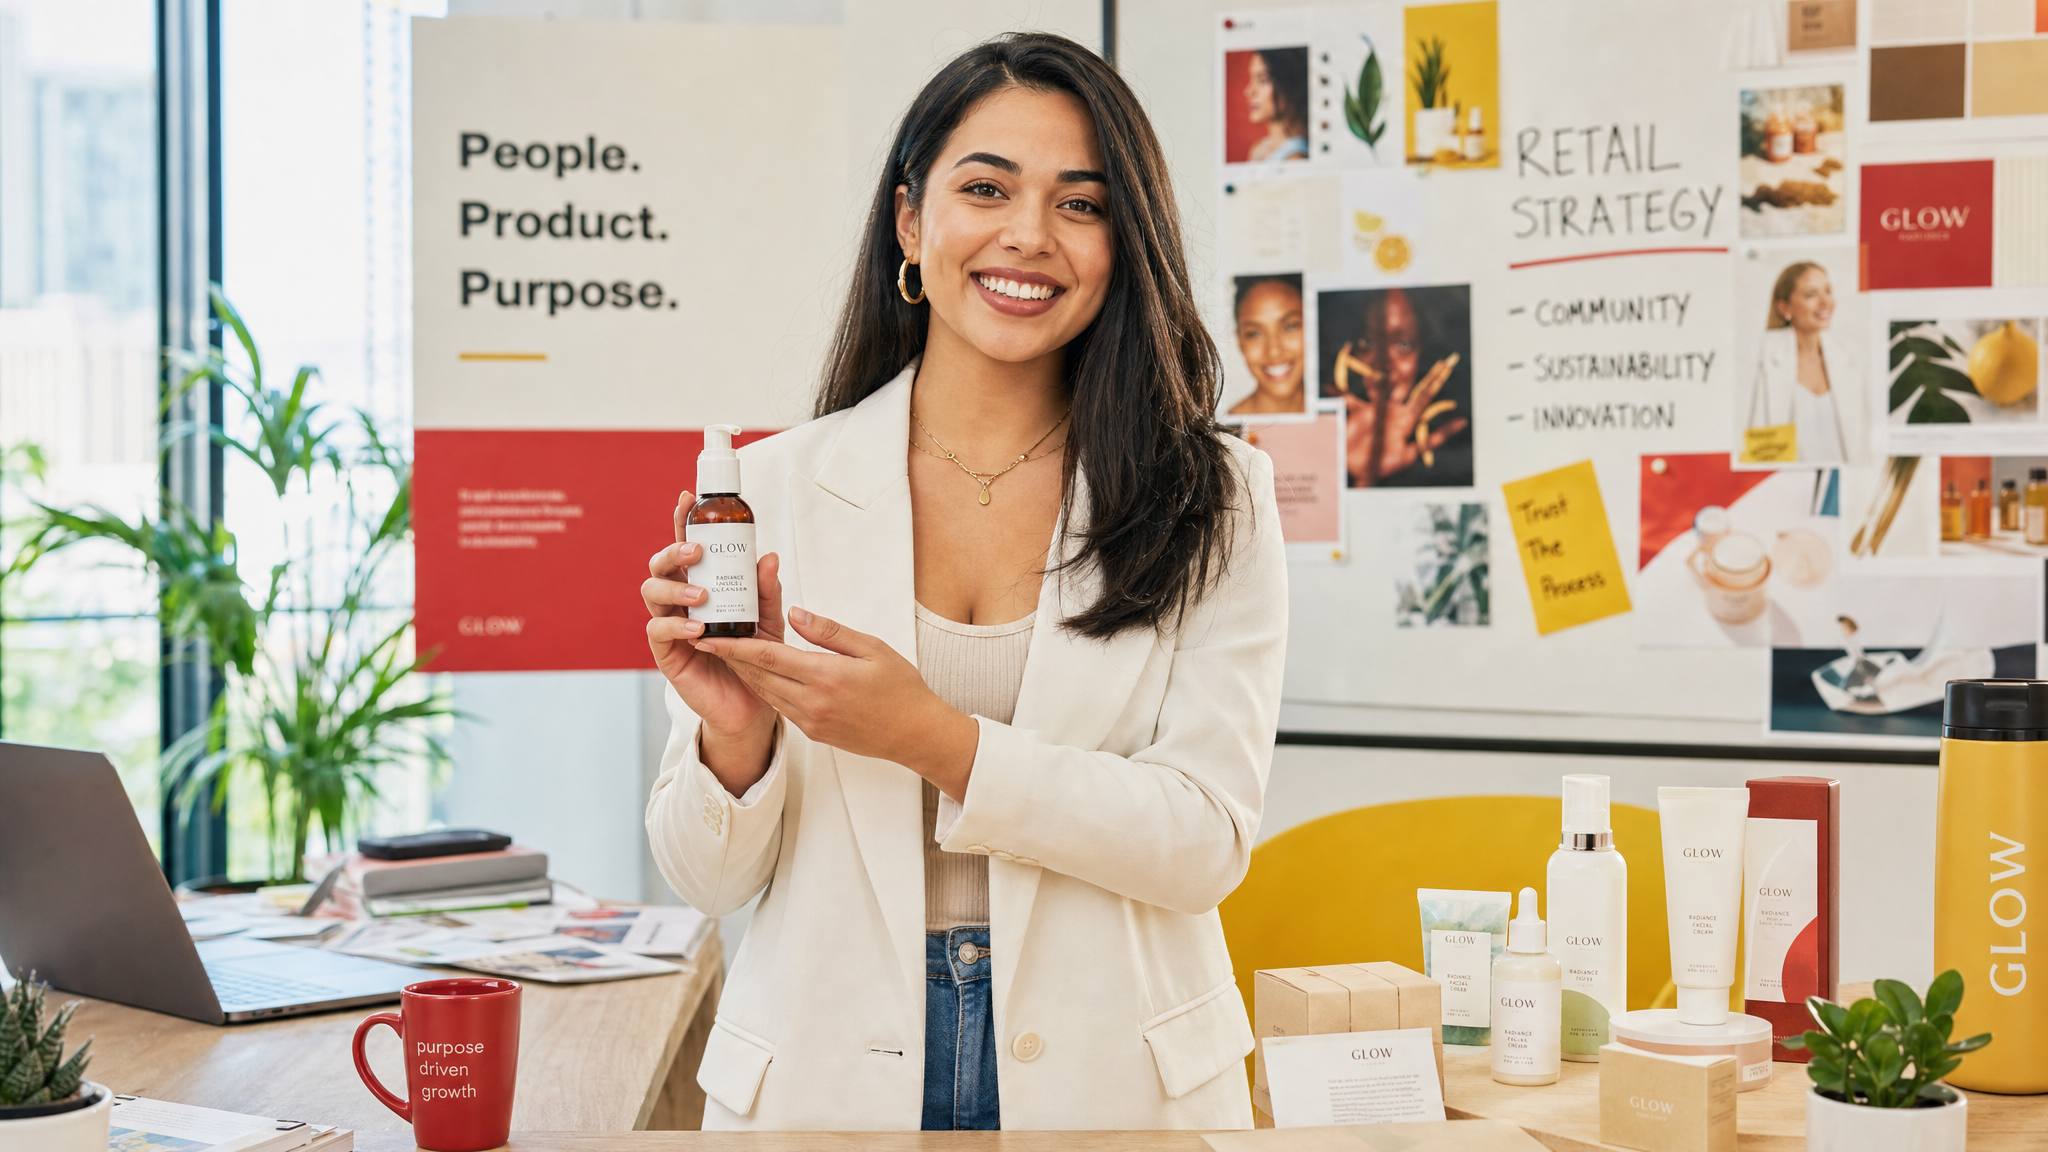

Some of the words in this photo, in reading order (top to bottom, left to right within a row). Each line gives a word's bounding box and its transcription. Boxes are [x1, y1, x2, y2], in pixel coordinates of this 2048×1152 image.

[459, 132, 641, 178] People.
[1517, 124, 1681, 178] RETAIL
[459, 201, 670, 241] Product.
[1511, 185, 1723, 239] STRATEGY
[1880, 205, 1970, 231] GLOW
[459, 269, 679, 317] Purpose.
[1534, 293, 1690, 327] COMMUNITY
[1533, 351, 1715, 382] SUSTAINABILITY
[1533, 402, 1675, 431] INNOVATION
[1516, 492, 1568, 525] Trust
[709, 543, 748, 553] GLOW
[1523, 537, 1565, 563] The
[1540, 571, 1607, 602] Process
[458, 616, 525, 637] GLOW
[1683, 848, 1724, 858] GLOW
[1759, 887, 1792, 897] GLOW
[1990, 831, 2027, 996] GLOW
[1445, 935, 1476, 945] GLOW
[1566, 936, 1603, 946] GLOW
[1501, 997, 1536, 1008] GLOW
[417, 1041, 484, 1057] purpose
[1351, 1047, 1393, 1060] GLOW
[420, 1060, 469, 1076] driven
[421, 1083, 477, 1101] growth
[1630, 1095, 1674, 1114] GLOW
